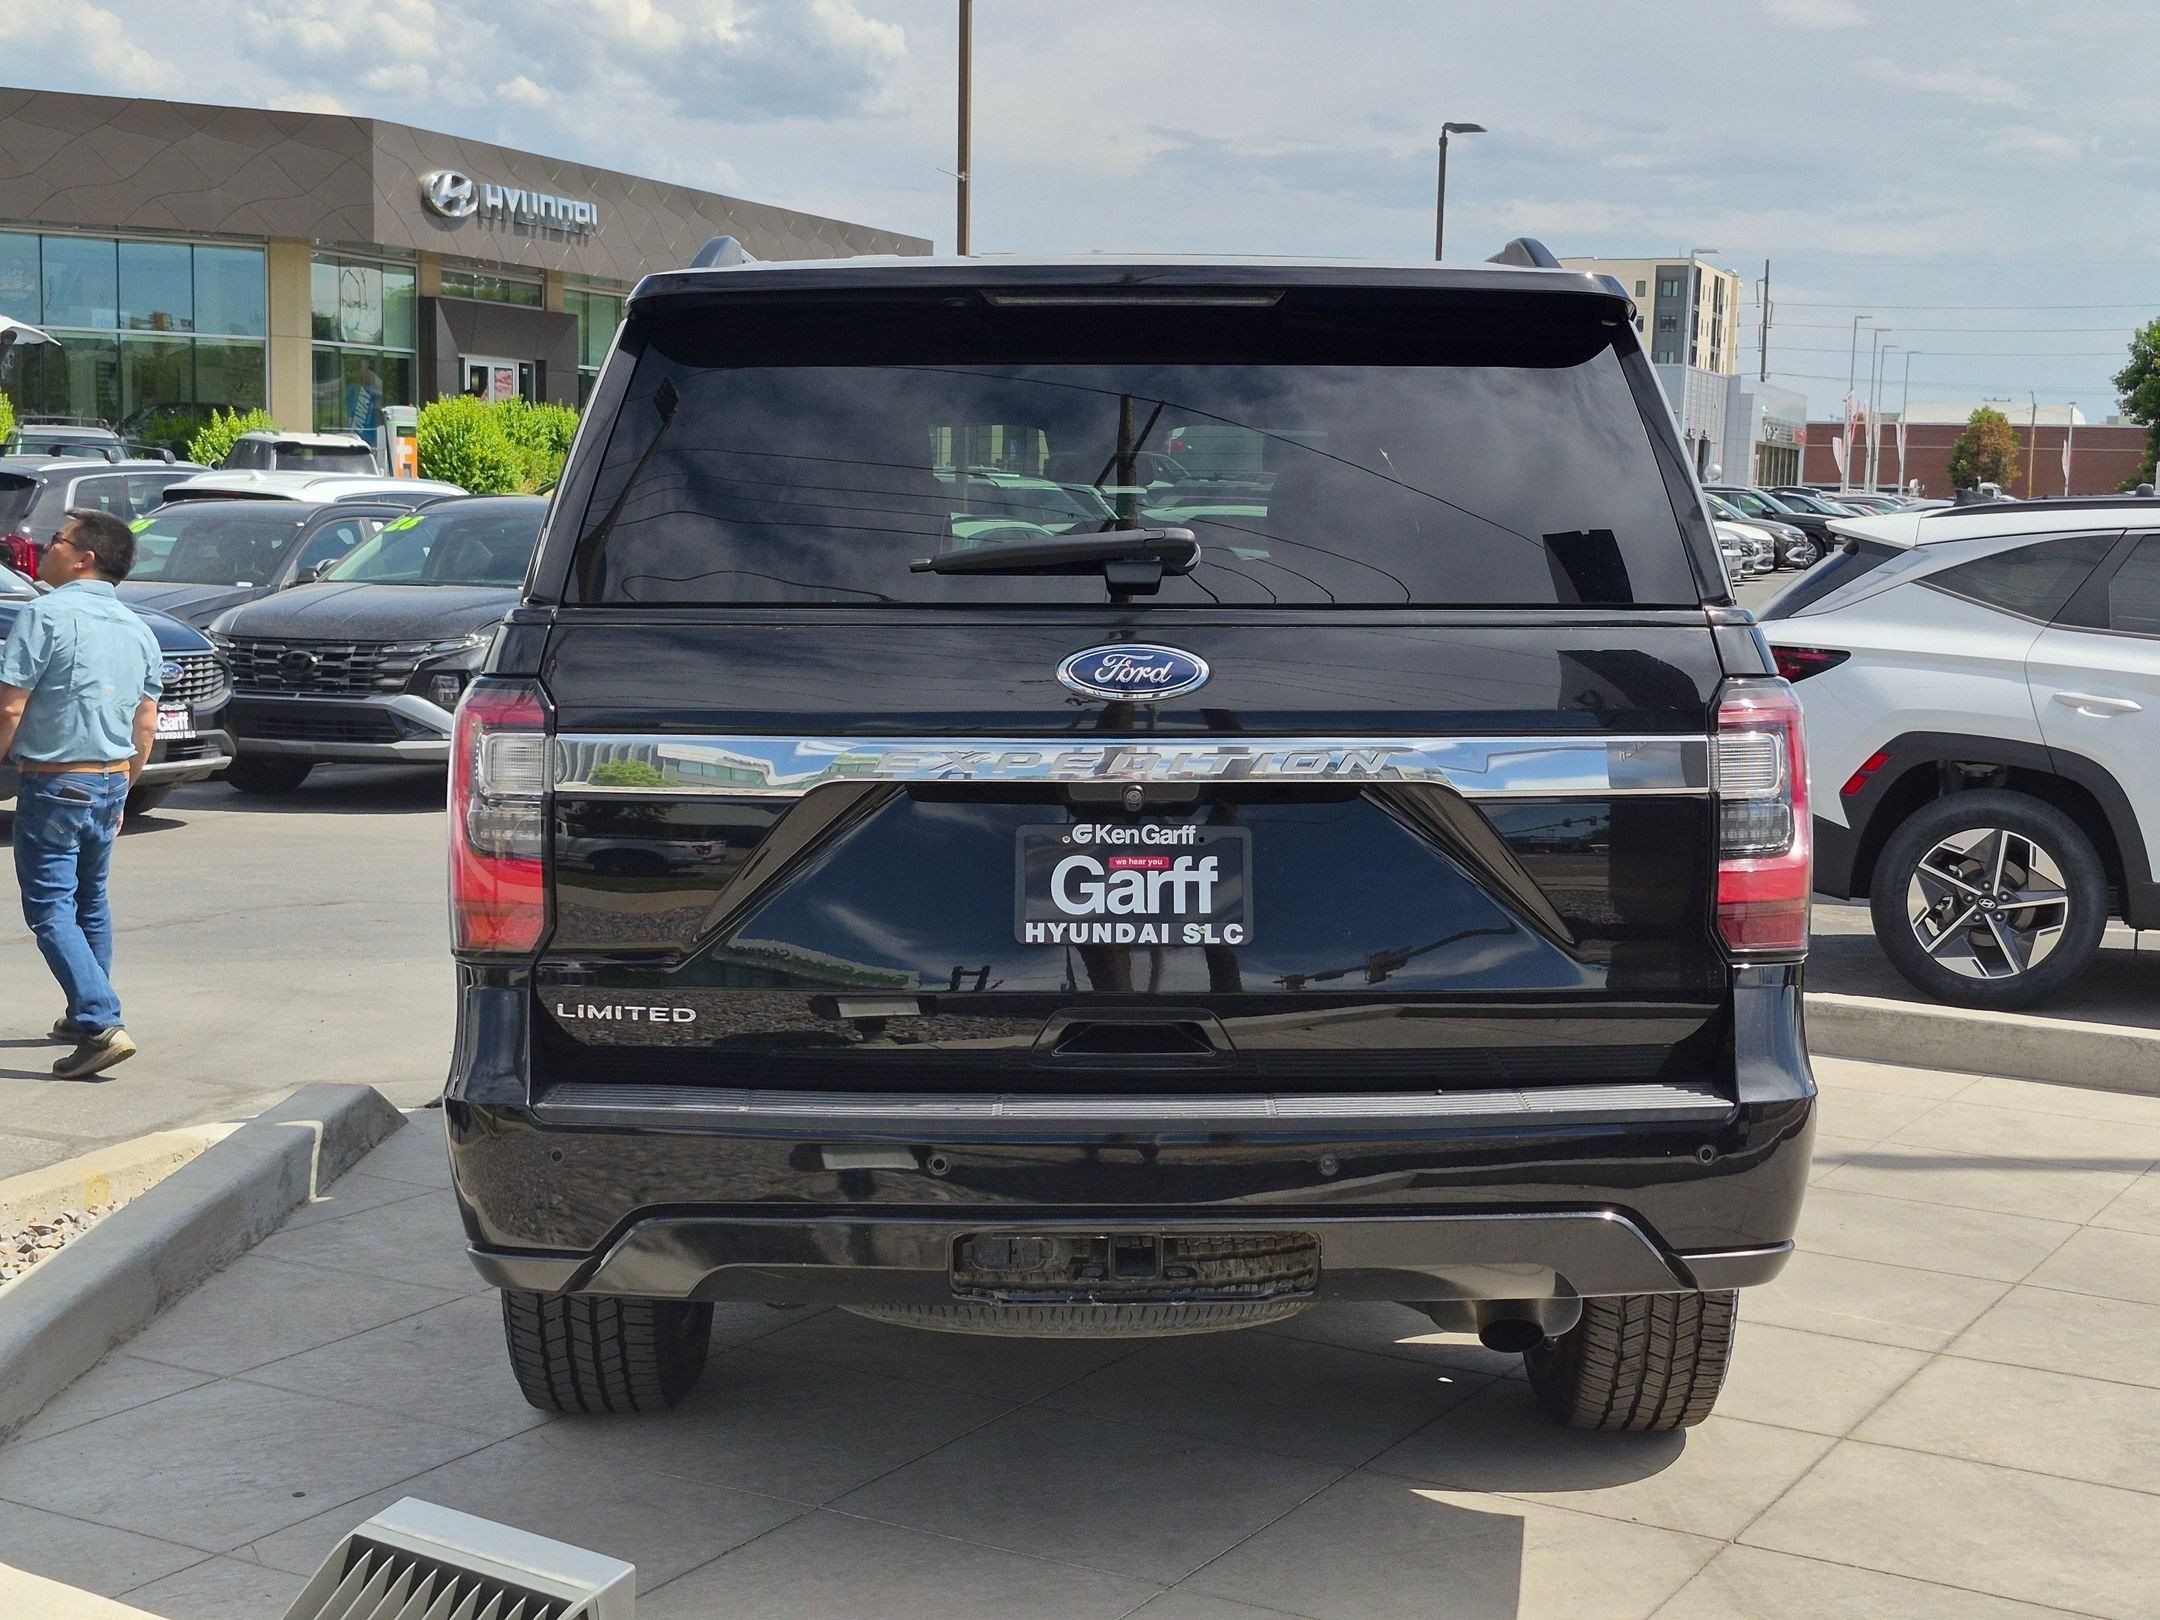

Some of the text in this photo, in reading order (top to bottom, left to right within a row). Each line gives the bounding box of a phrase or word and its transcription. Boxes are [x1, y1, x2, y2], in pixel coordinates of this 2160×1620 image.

[483, 184, 598, 227] HYUNDAI
[1094, 653, 1174, 684] Ford
[873, 750, 1392, 775] EXPEDITION
[1095, 824, 1139, 844] Ken
[1141, 824, 1197, 845] Garff
[1128, 857, 1147, 866] hear
[1148, 859, 1163, 868] you
[1050, 854, 1219, 915] Garff
[1025, 922, 1244, 945] HYUNDAI SLC
[557, 1003, 697, 1023] LIMITED
